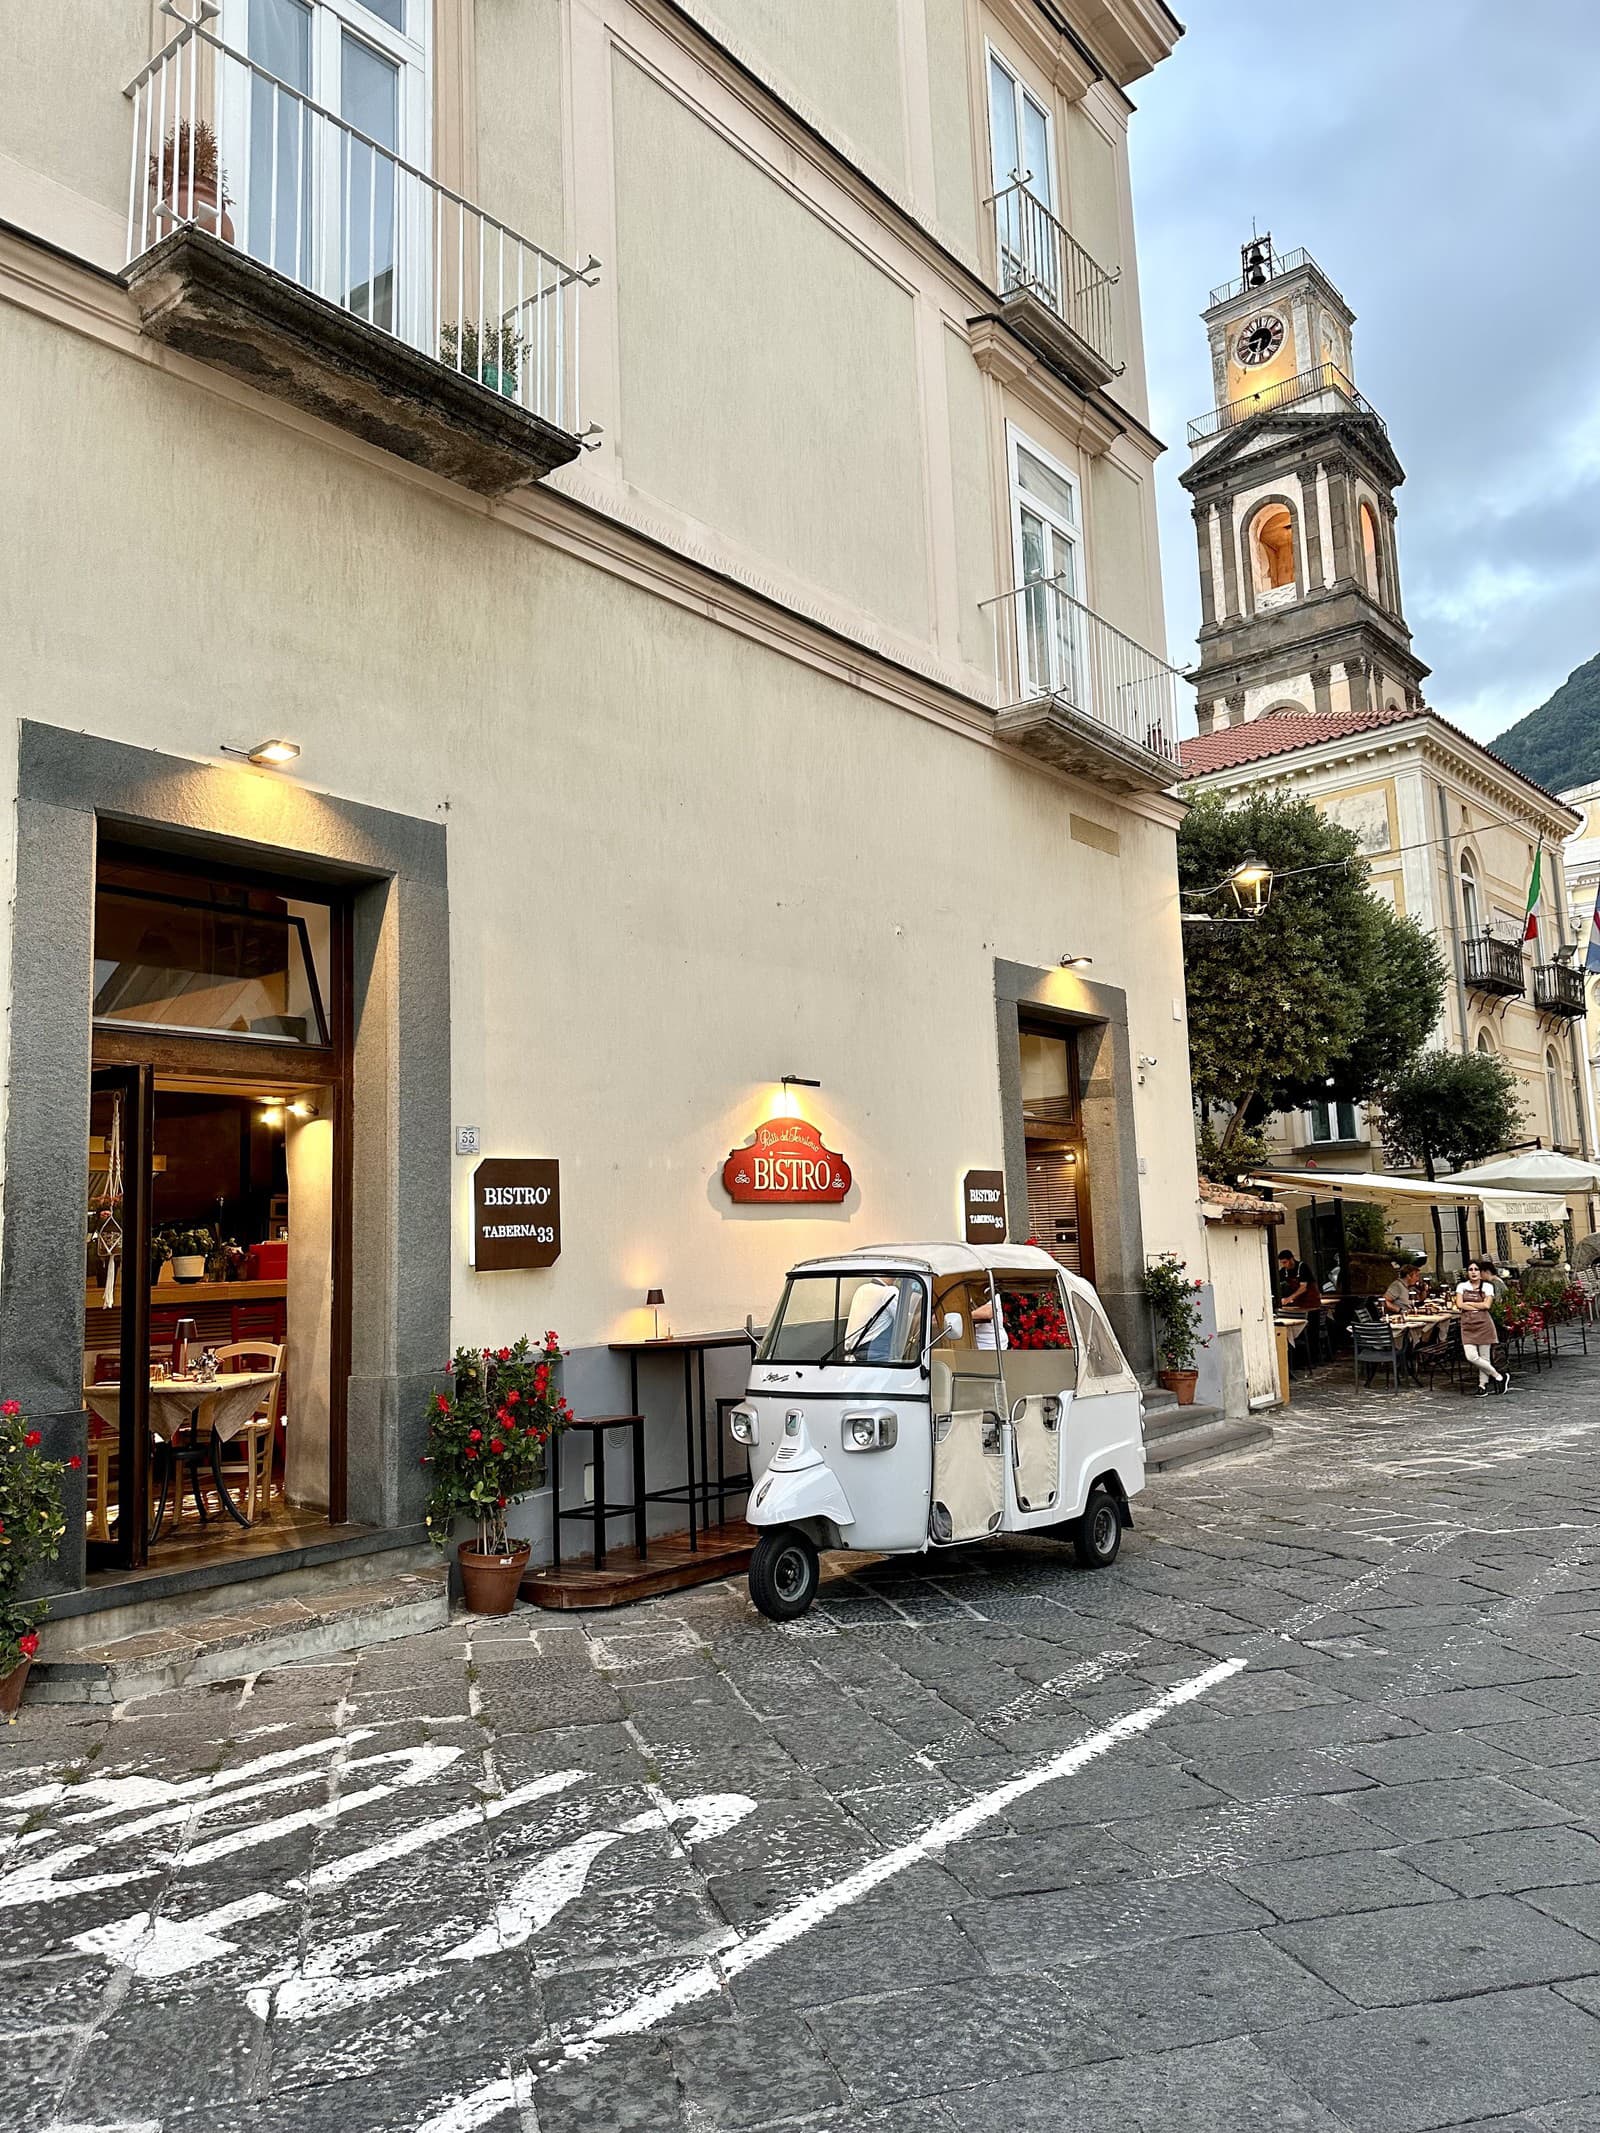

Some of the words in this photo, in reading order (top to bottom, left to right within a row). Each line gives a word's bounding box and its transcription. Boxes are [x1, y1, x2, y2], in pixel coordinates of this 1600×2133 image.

[461, 1131, 475, 1144] 33
[483, 1187, 551, 1206] BISTRO'
[994, 1216, 1004, 1229] 33
[482, 1224, 537, 1238] TABERNA
[537, 1226, 554, 1243] 33
